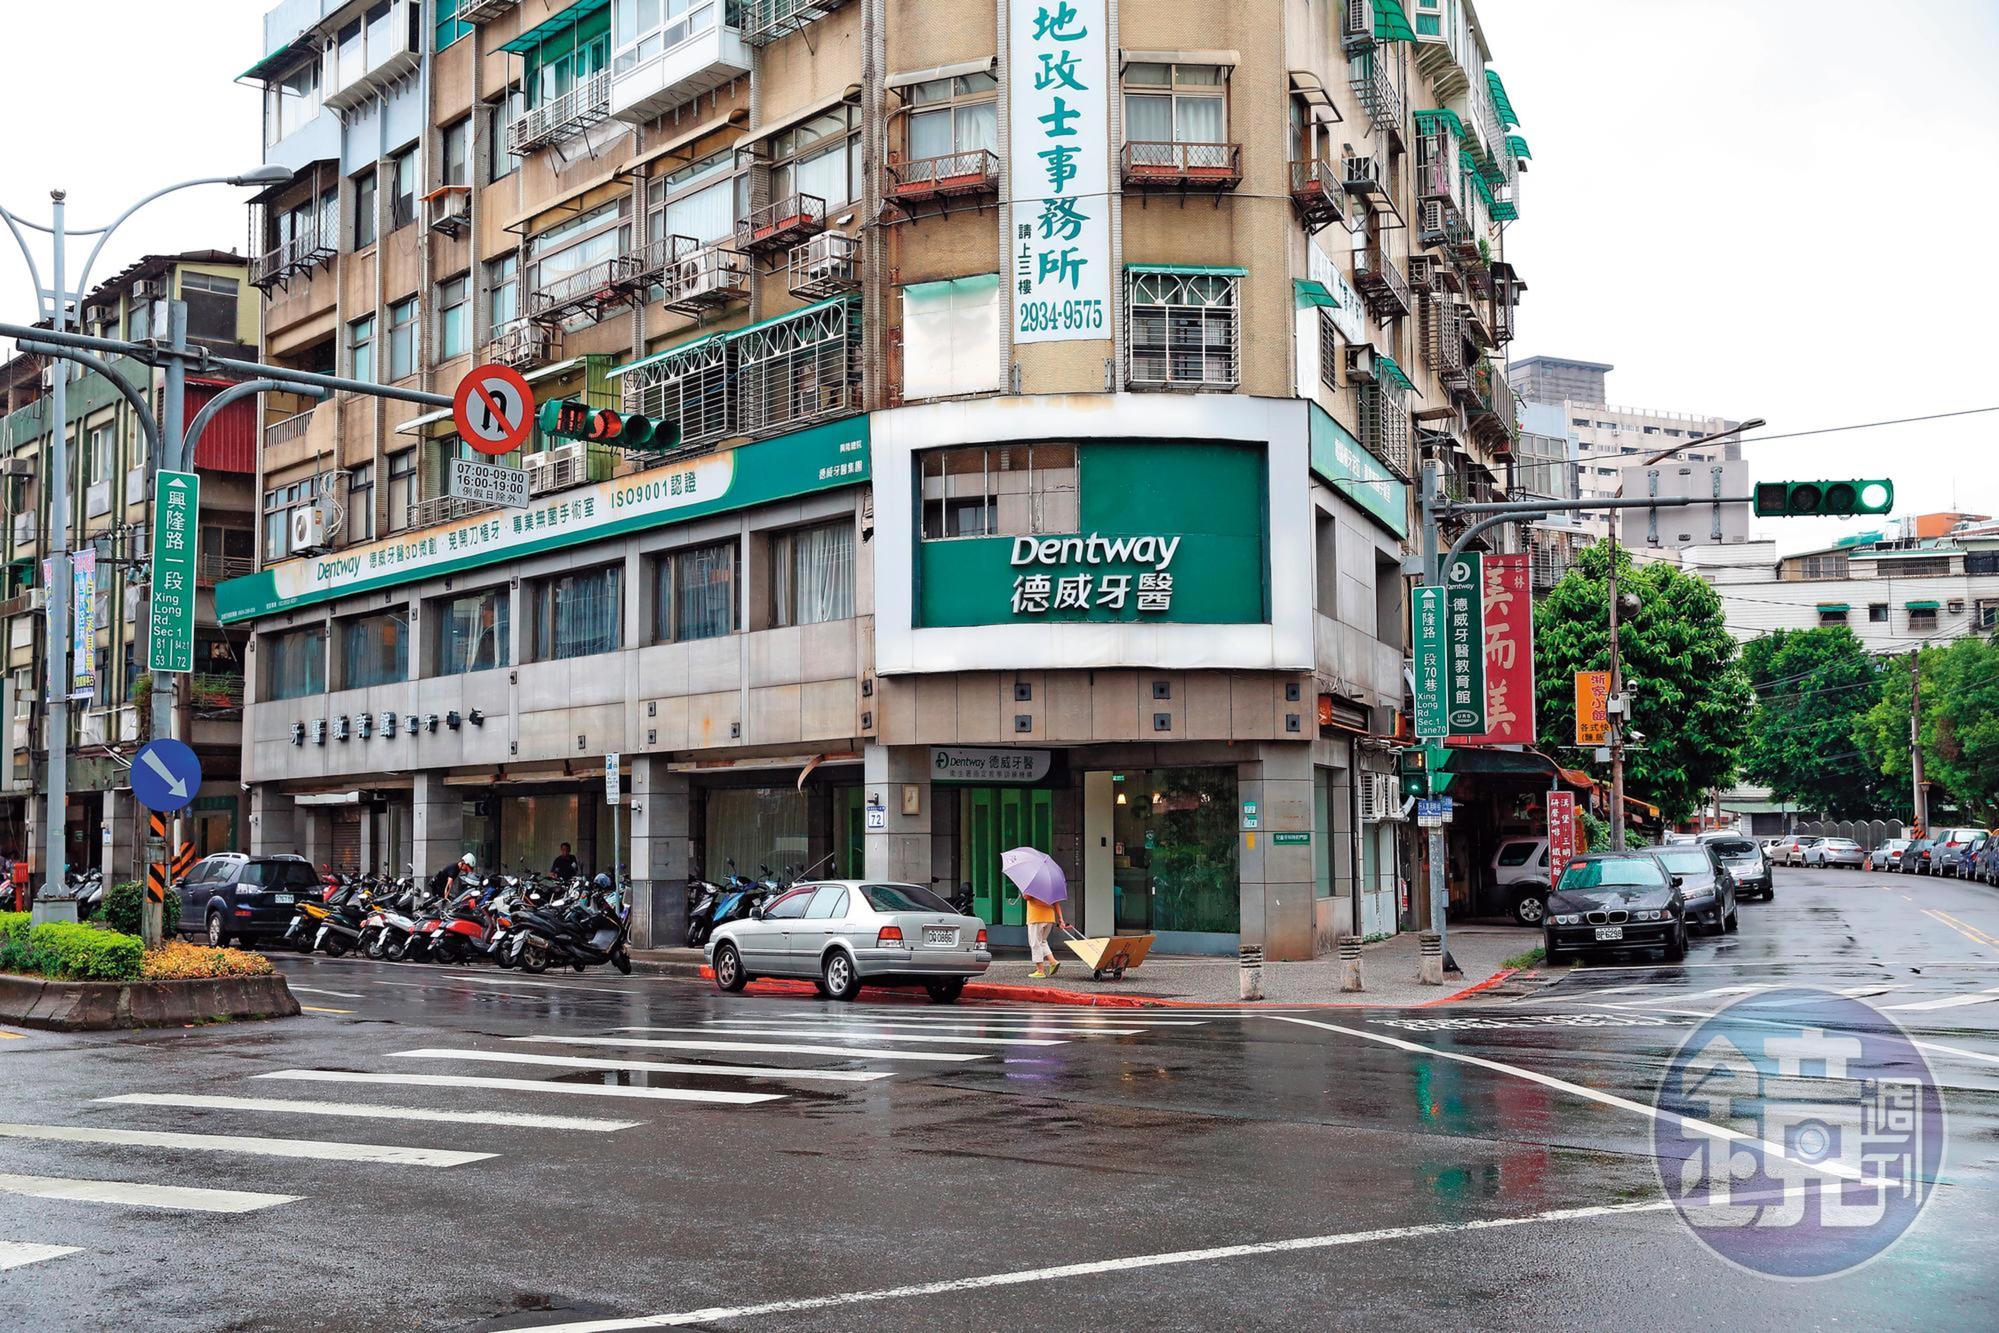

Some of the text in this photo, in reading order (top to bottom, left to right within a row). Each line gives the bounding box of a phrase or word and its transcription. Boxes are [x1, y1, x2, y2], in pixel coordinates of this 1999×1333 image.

[1032, 1, 1091, 291] 地政士事務所
[1018, 223, 1032, 295] 請上三樓
[1020, 299, 1103, 332] 2934-9575
[457, 463, 524, 483] 07:00-09:00
[457, 475, 523, 494] 16:00-19:00
[317, 555, 361, 581] Dentway
[611, 471, 697, 508] ISO9001認證
[164, 490, 186, 591] 興隆路一段
[1010, 531, 1181, 571] Dentway
[155, 592, 179, 605] Xing
[1010, 573, 1174, 614] 德威牙醫
[153, 615, 171, 625] Rd.
[154, 604, 182, 617] Long
[153, 625, 174, 637] Sec
[156, 638, 166, 649] 81
[1422, 599, 1438, 692] 興隆路一段70巷
[1452, 597, 1471, 705] 德威牙醫教育館
[1484, 560, 1517, 736] 美而美
[155, 655, 165, 666] 53
[177, 655, 187, 667] 72
[1417, 693, 1436, 703] Xing
[1417, 701, 1438, 711] Long
[950, 755, 1034, 770] Dentway 德威牙醫
[871, 814, 881, 825] 72
